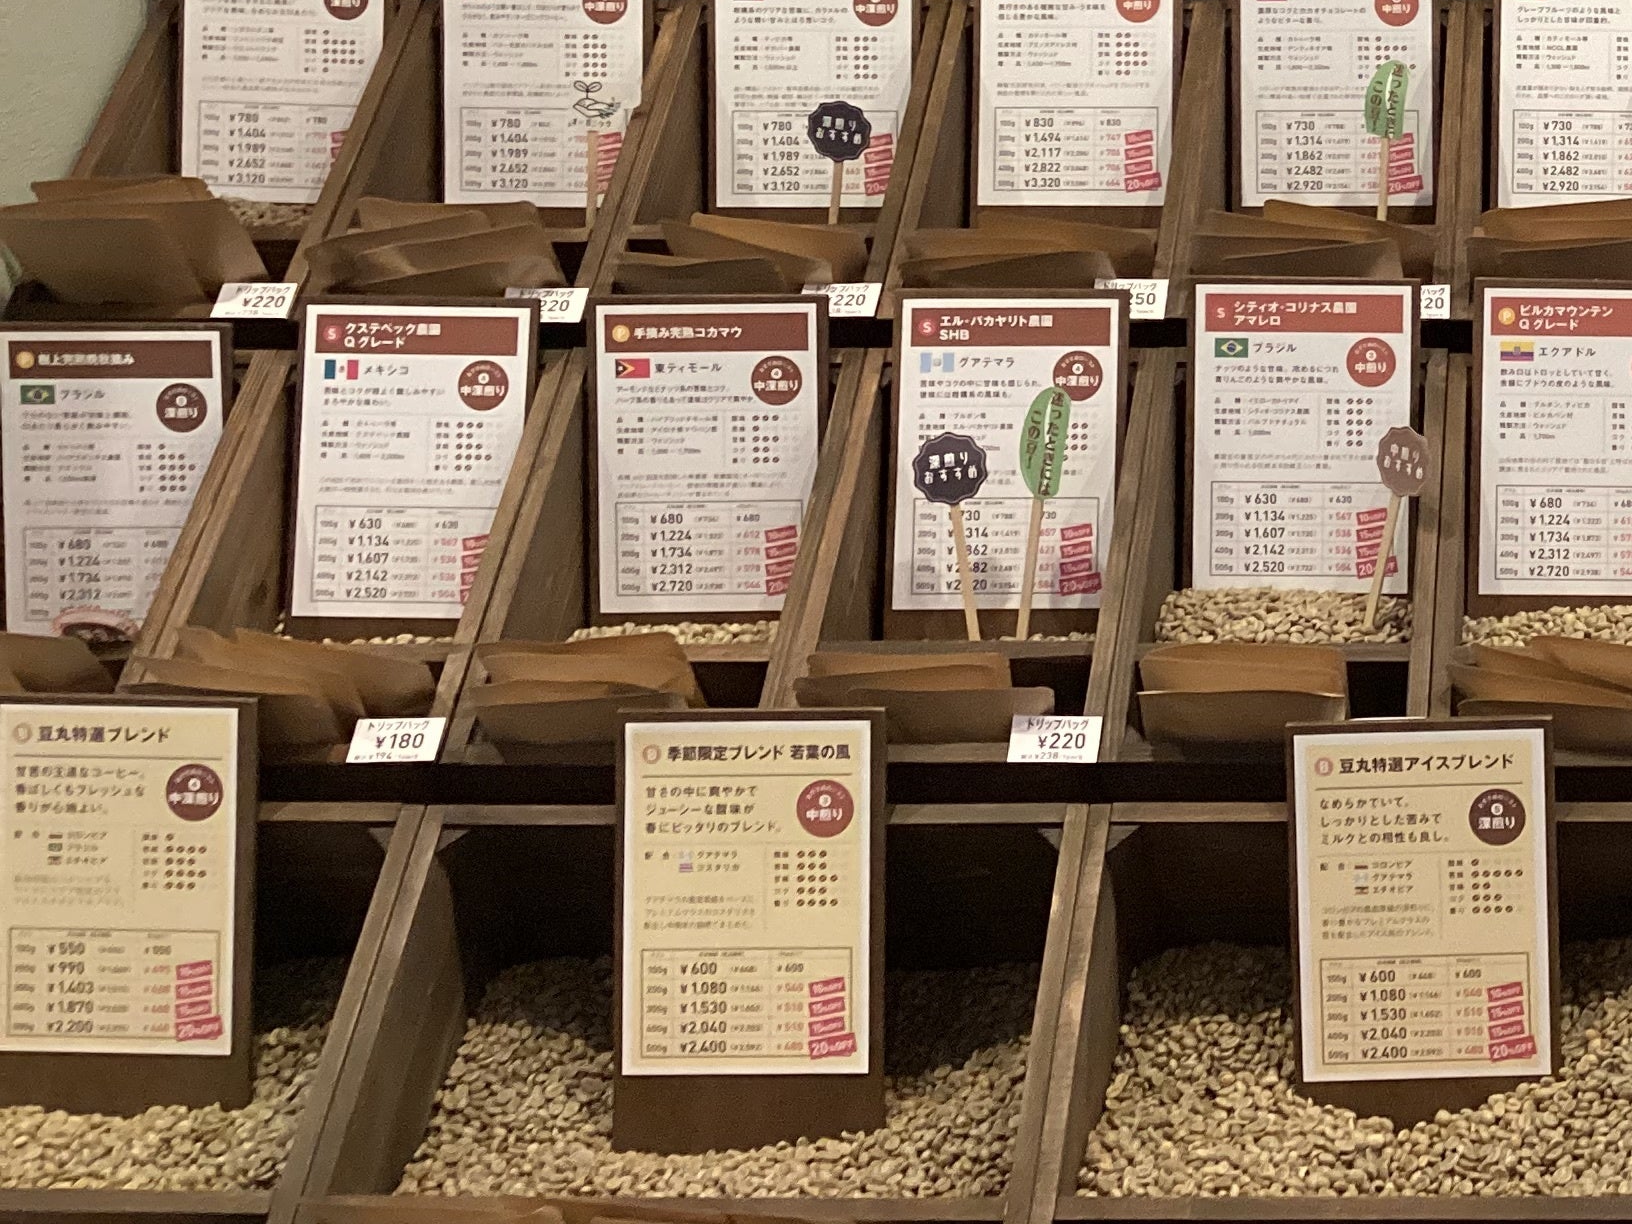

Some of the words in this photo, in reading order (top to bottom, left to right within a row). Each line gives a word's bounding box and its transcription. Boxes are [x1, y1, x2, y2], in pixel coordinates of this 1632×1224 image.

[242, 296, 285, 308] ¥220
[1234, 314, 1281, 327] アマレロ
[940, 330, 970, 342] SHB
[1539, 345, 1596, 358] エクアドル
[655, 362, 722, 375] 東ティモール
[958, 356, 1015, 369] グアテマラ
[37, 726, 170, 743] 豆丸特選ブレンド
[376, 733, 424, 749] ¥180
[1038, 733, 1085, 749] ¥220
[667, 745, 786, 762] 季節限定ブレンド
[790, 744, 851, 761] 若葉の風
[1339, 754, 1514, 775] 豆丸特選アイスブレンド
